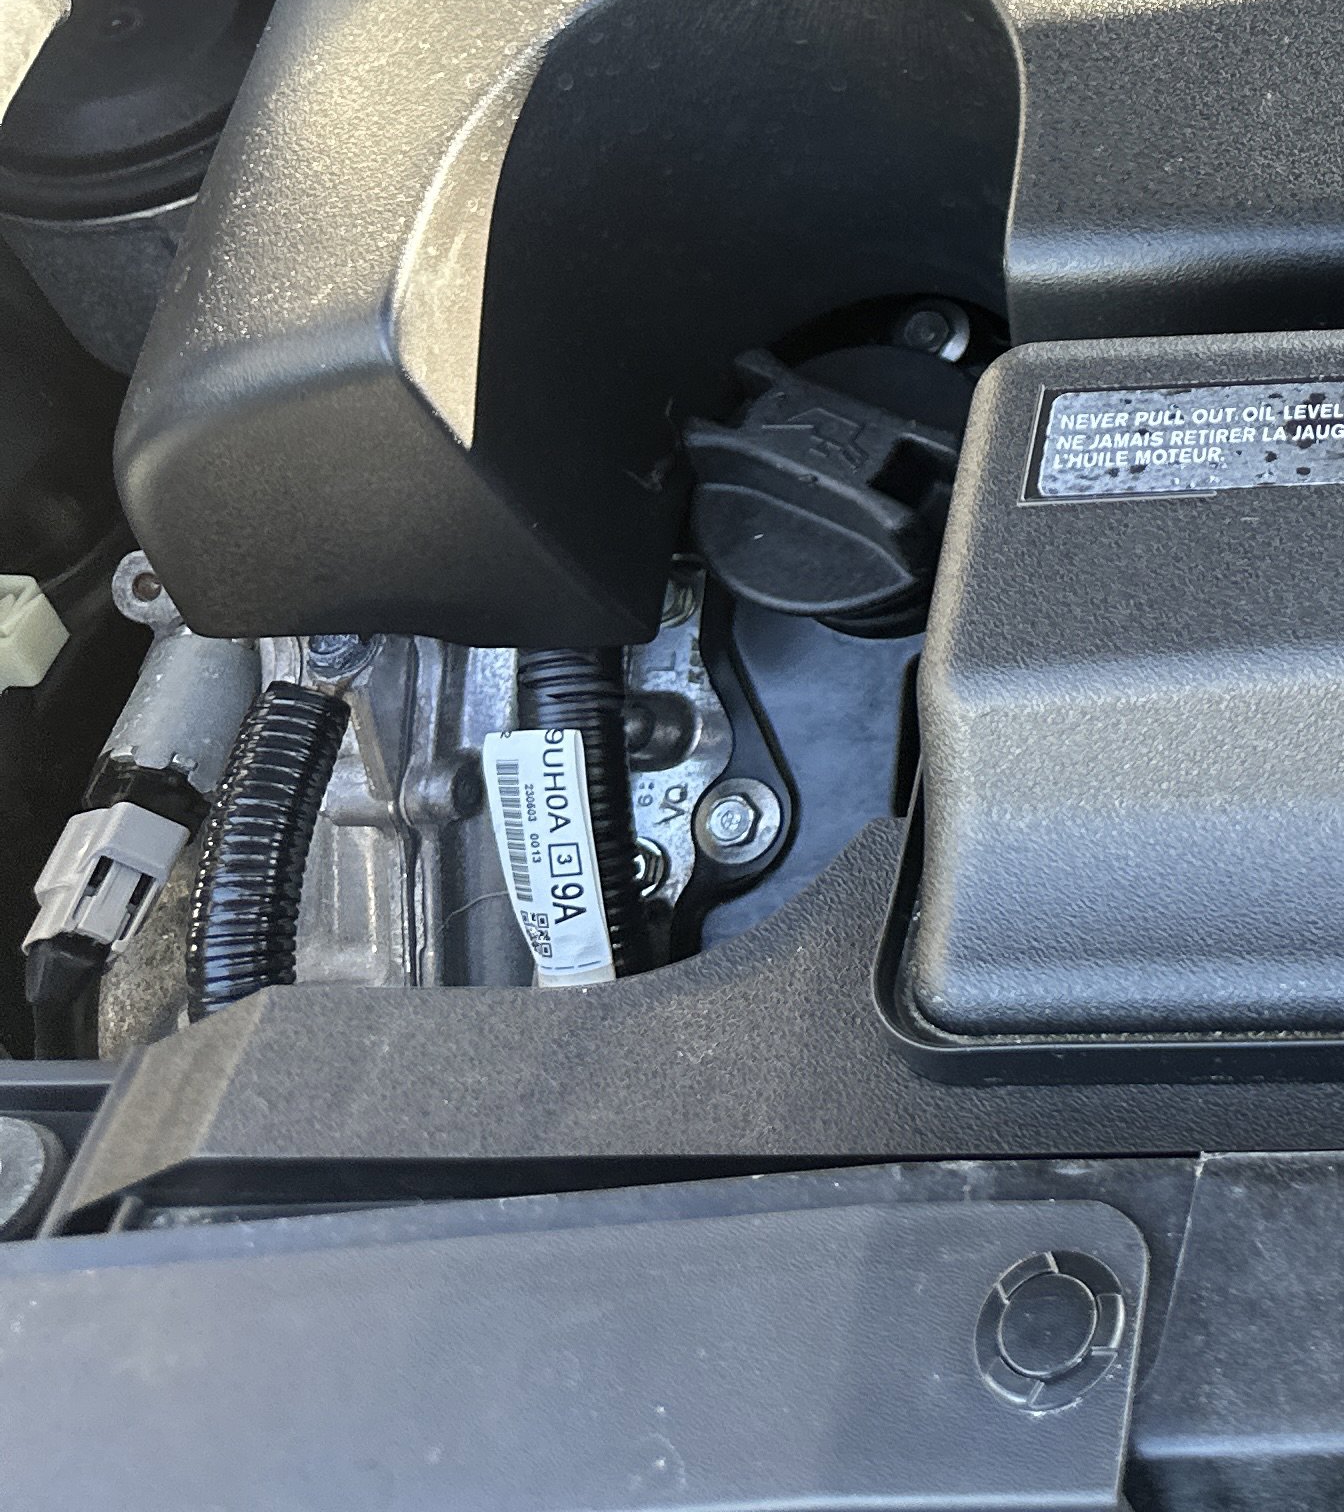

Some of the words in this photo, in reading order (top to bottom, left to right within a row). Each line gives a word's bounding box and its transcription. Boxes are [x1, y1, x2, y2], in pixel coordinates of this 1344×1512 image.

[1059, 412, 1128, 430] NEVER
[1135, 409, 1185, 428] PULL
[1192, 407, 1235, 425] OUT
[1242, 405, 1275, 423] OIL
[1283, 402, 1343, 420] LEVEL
[1056, 434, 1085, 451] NE
[1088, 431, 1164, 449] JAMAIS
[1169, 427, 1256, 446] RETIRER
[1262, 426, 1288, 443] LA
[1053, 449, 1129, 470] L'HUILE
[1135, 446, 1225, 465] MOTEUR.
[524, 783, 537, 822] 230603
[530, 833, 541, 864] 0013
[550, 882, 587, 925] 9A
